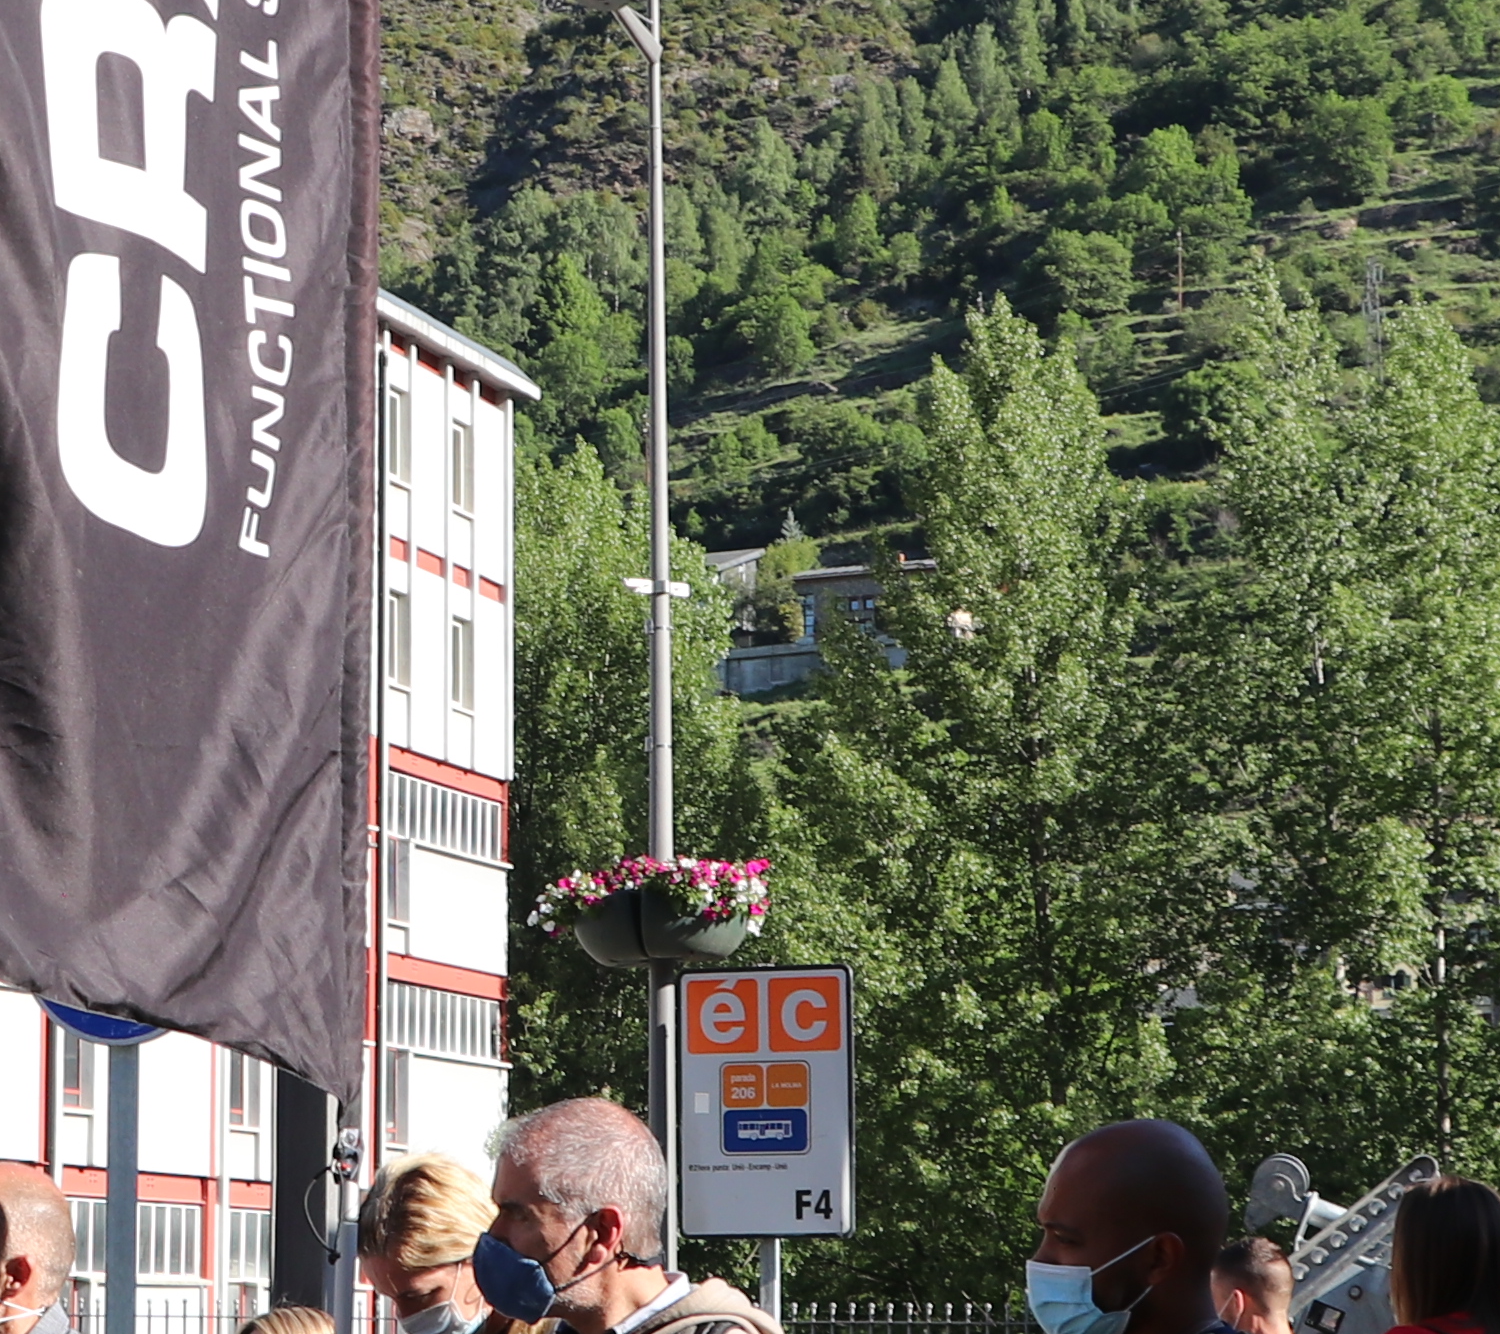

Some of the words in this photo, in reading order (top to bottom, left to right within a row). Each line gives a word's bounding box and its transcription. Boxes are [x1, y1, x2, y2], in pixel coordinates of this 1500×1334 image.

[239, 39, 296, 558] FUNCTIONAL
[730, 1073, 756, 1085] parada
[731, 1087, 756, 1100] 206
[795, 1190, 832, 1220] F4
